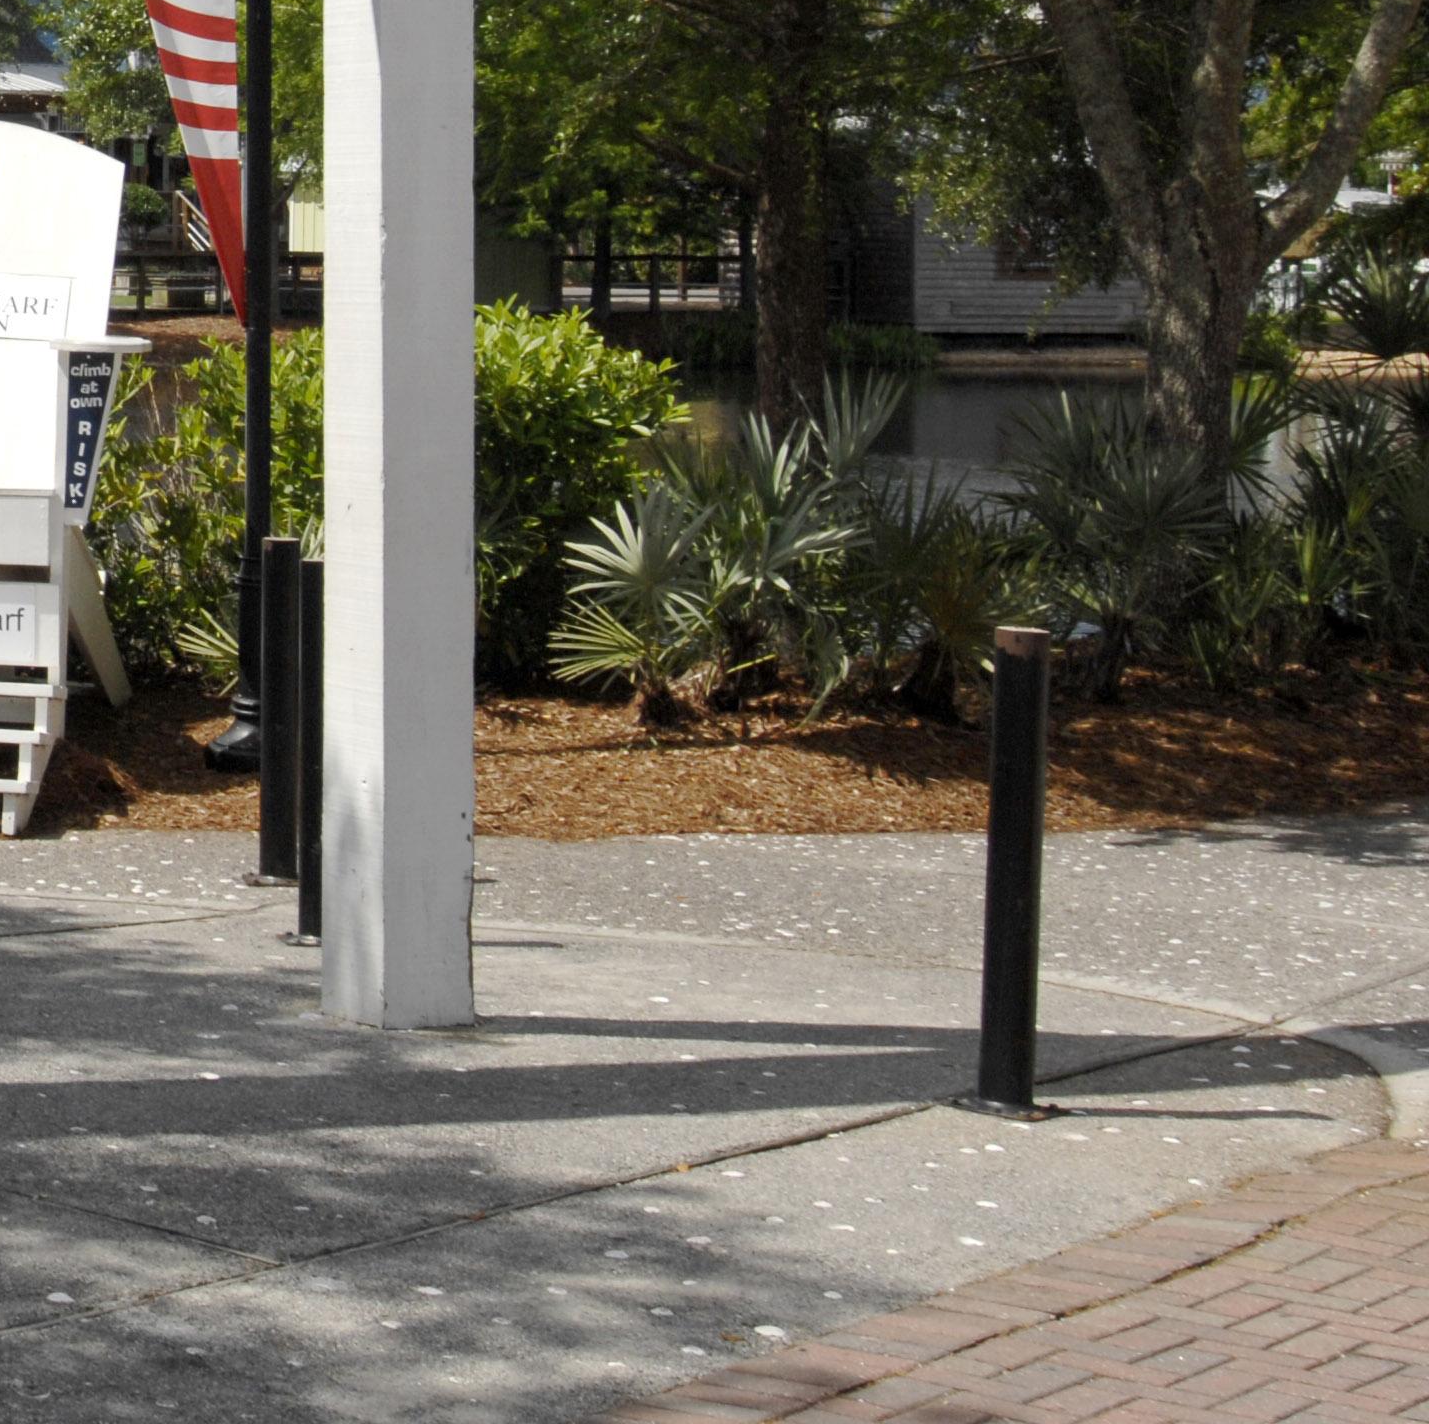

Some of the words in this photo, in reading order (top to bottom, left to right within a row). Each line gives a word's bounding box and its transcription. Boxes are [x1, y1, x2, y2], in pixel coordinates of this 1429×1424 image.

[70, 362, 112, 377] climb
[80, 381, 98, 394] at
[70, 396, 103, 409] own
[69, 421, 91, 498] RISK
